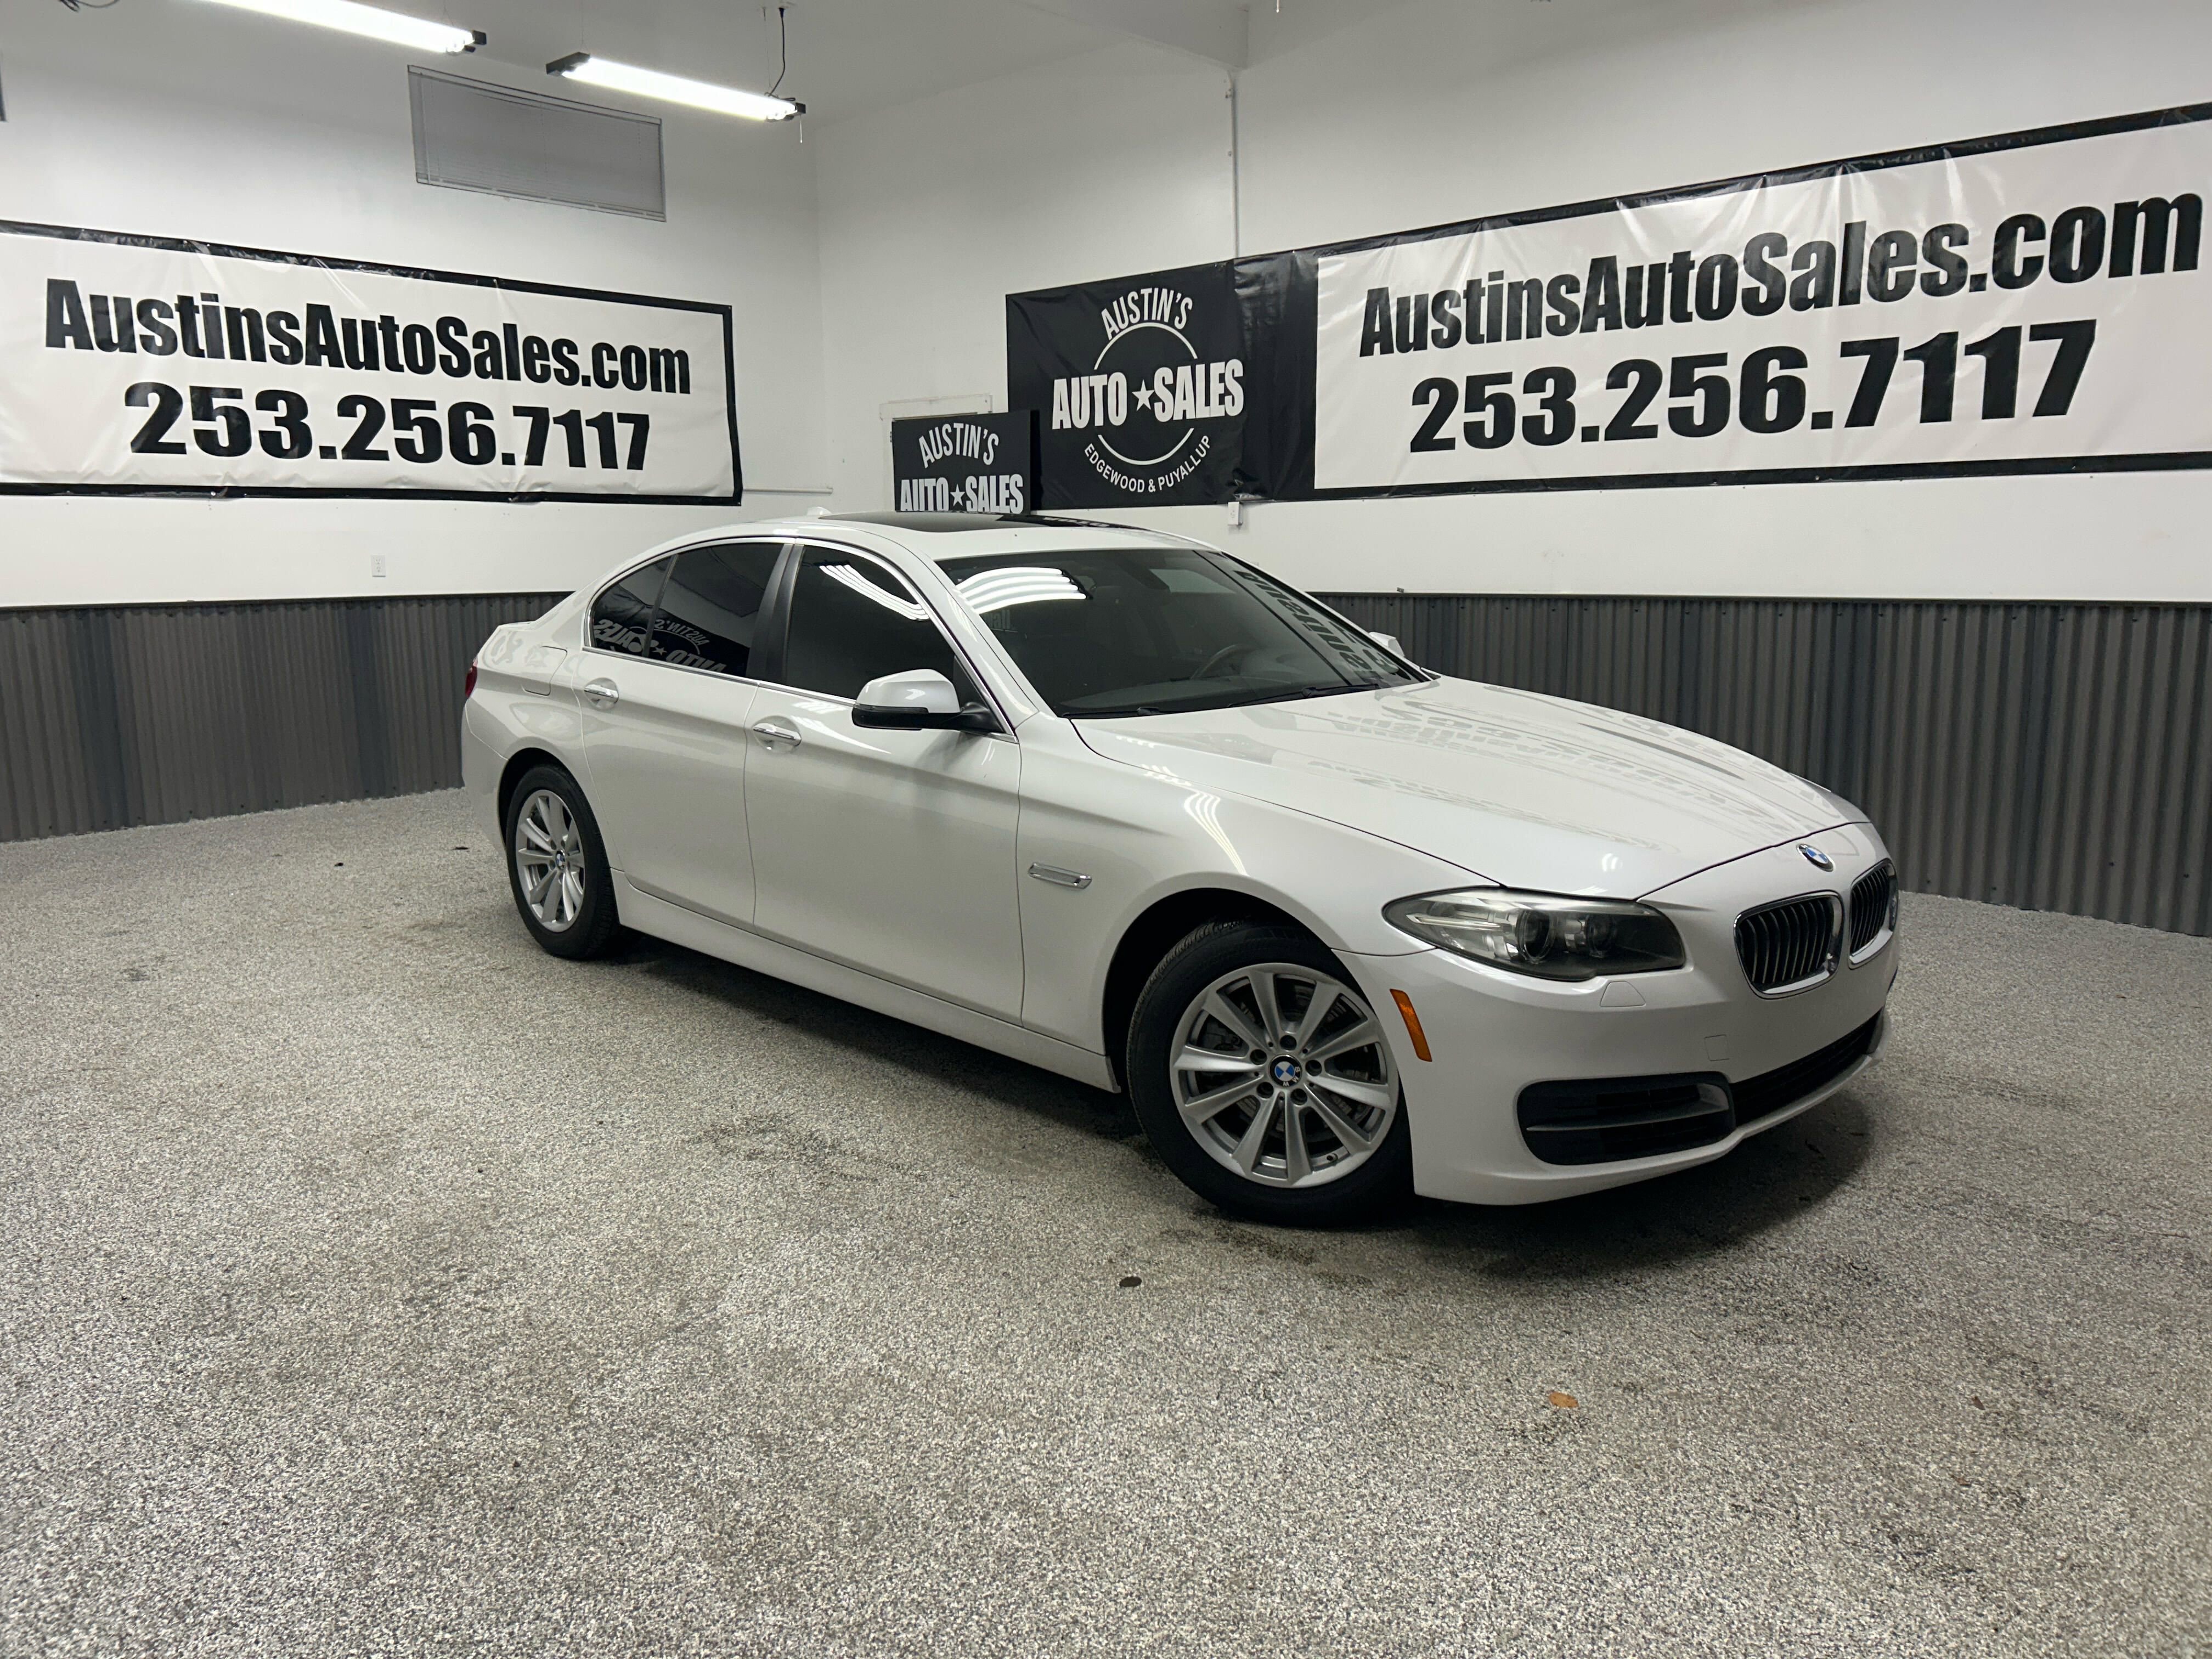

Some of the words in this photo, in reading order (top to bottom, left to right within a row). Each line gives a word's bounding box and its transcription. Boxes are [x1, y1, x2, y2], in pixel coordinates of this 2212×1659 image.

[1359, 193, 2204, 358] AustinsAutoSales.com
[46, 278, 691, 395] AustinsAutoSales.com
[1101, 287, 1194, 340] AUSTIN'S
[1052, 371, 1128, 430] AUTO
[1153, 359, 1245, 422] SALES
[1409, 319, 2098, 453] 253.256.7117
[123, 382, 651, 471] 253.256.7117
[918, 422, 1000, 469] AUSTIN'S
[900, 477, 950, 512] AUTO
[965, 473, 1024, 515] SALES
[1085, 443, 1145, 493] EDGEWOOD
[1148, 478, 1156, 493] &
[1158, 435, 1211, 490] PUYALLUP
